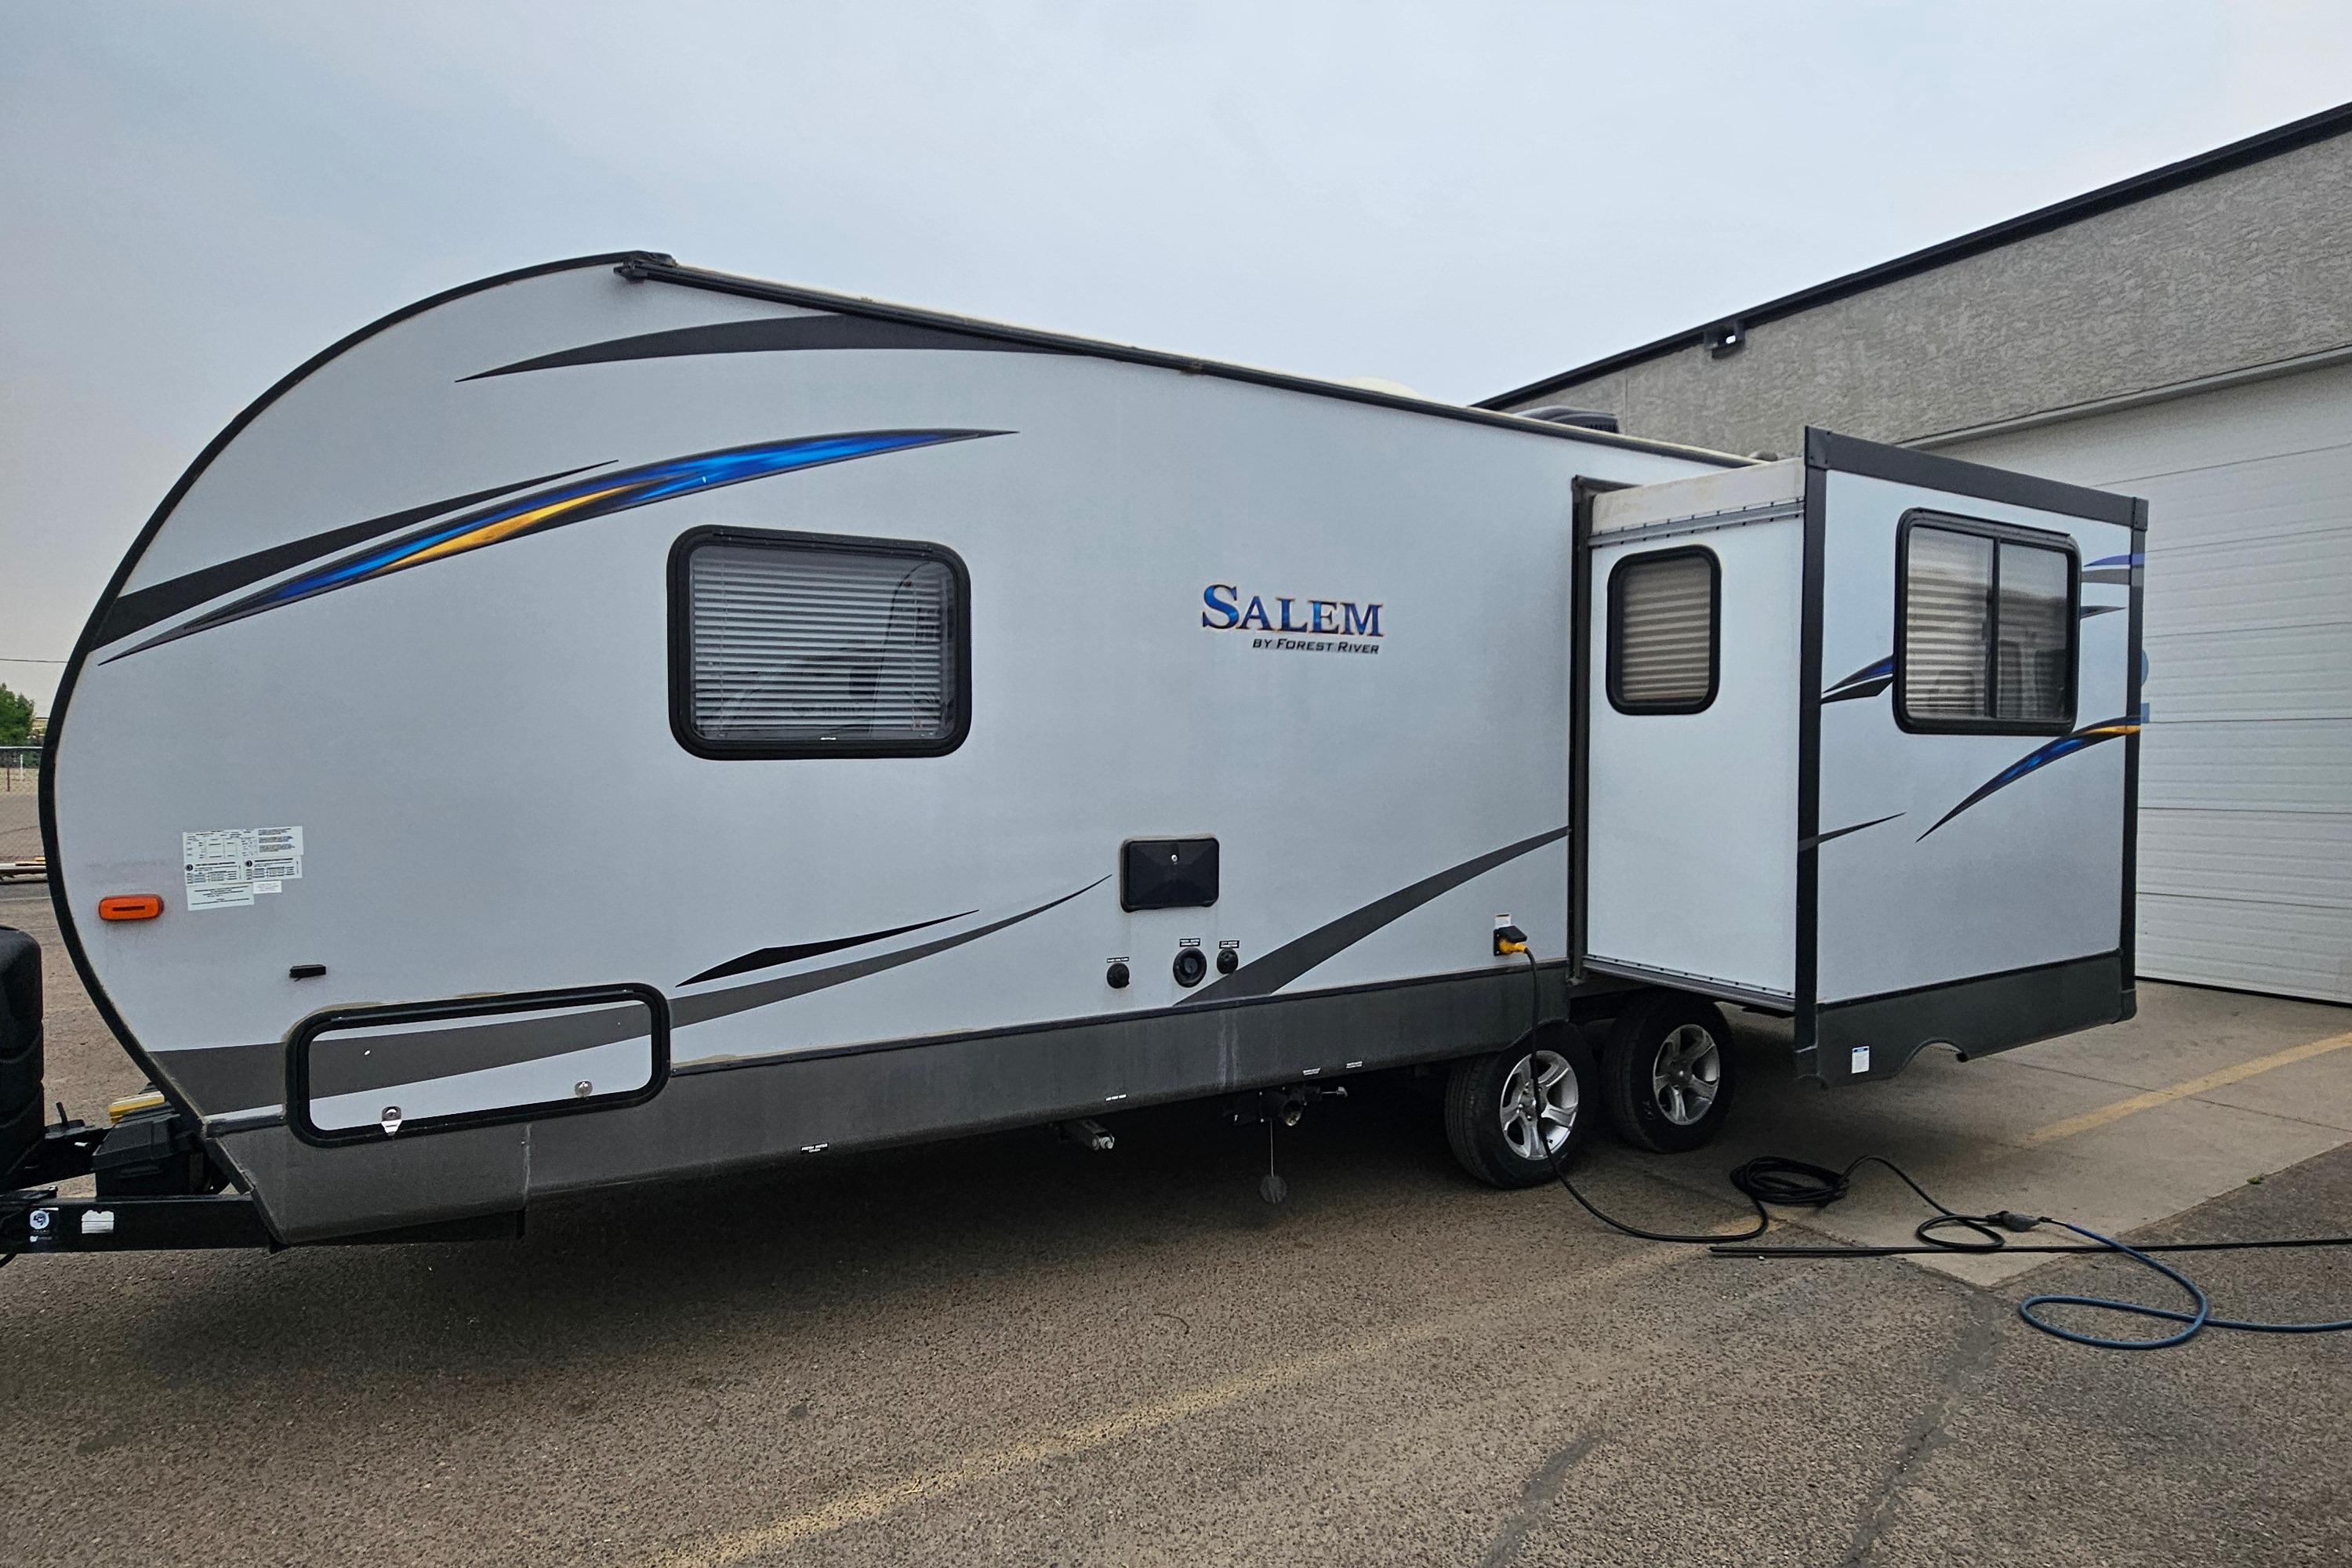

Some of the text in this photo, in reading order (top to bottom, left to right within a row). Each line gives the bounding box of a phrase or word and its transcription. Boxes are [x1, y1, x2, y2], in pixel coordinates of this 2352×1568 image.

[1201, 583, 1384, 637] SALEM
[1252, 637, 1380, 655] BY FOREST RIVER
